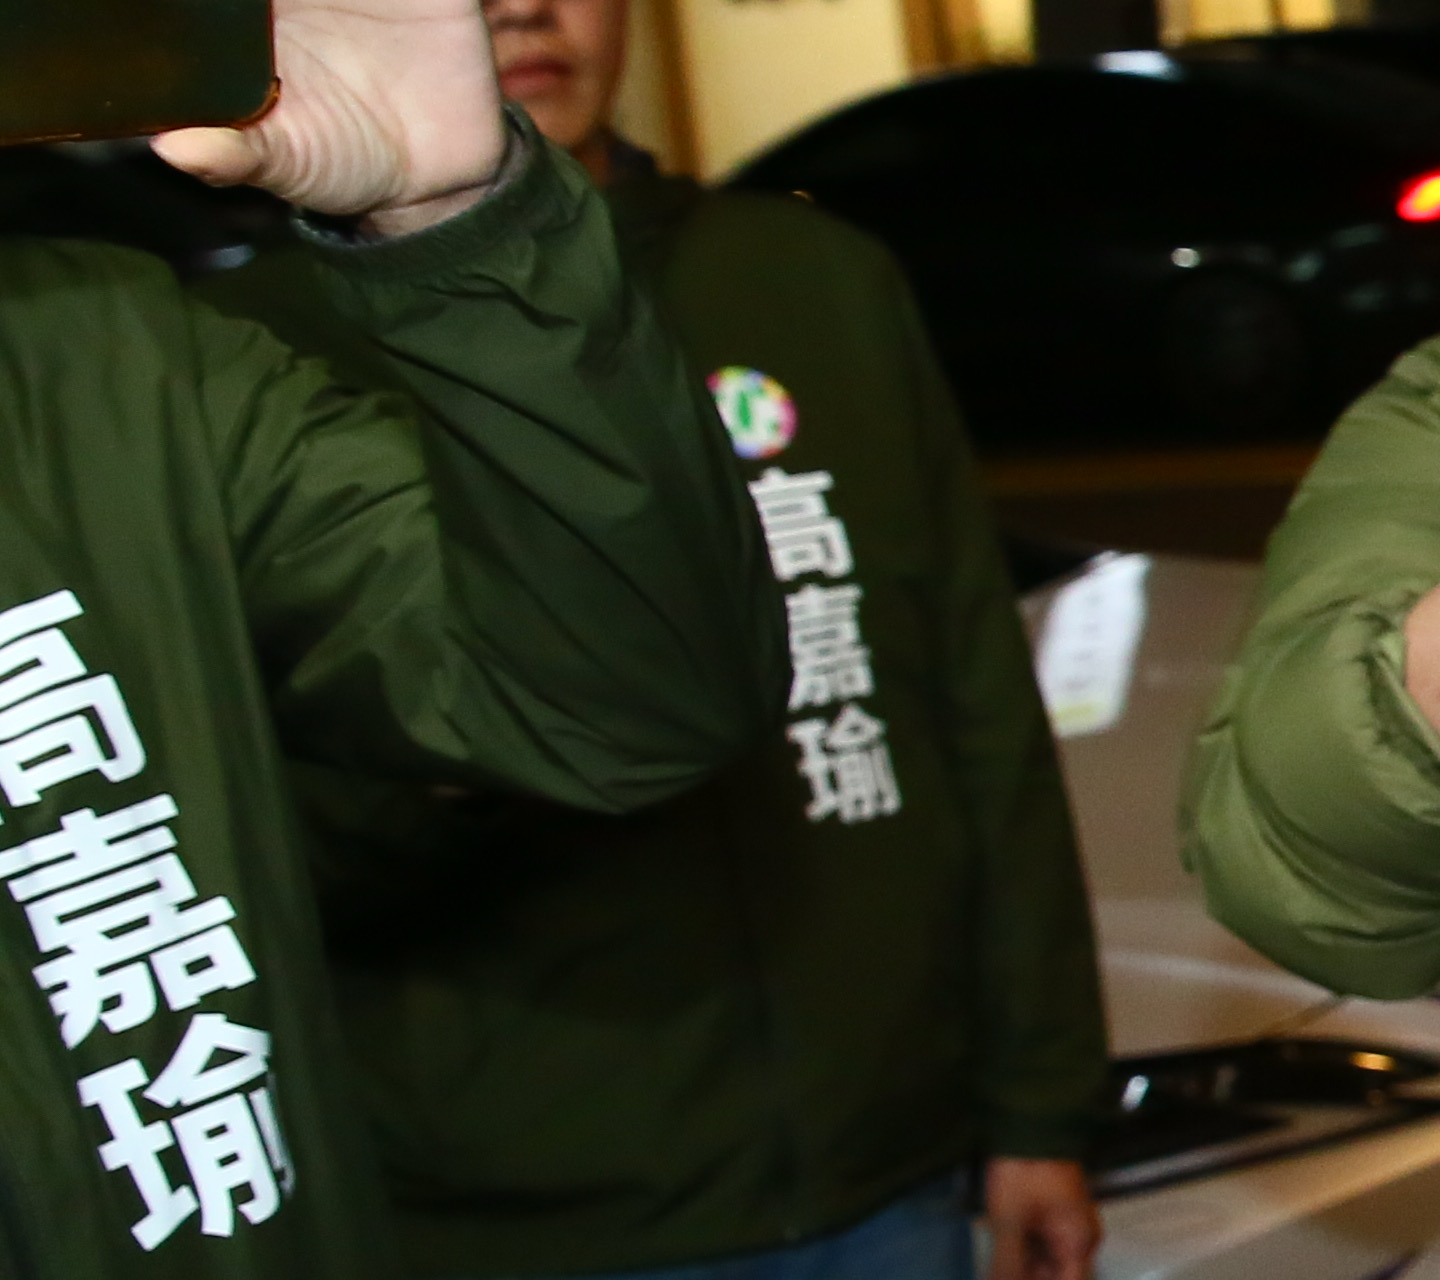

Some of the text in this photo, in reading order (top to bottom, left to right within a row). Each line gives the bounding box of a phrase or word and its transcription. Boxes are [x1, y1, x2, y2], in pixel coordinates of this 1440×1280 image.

[747, 466, 901, 824] 高嘉瑜
[0, 588, 294, 1252] 高嘉瑜
